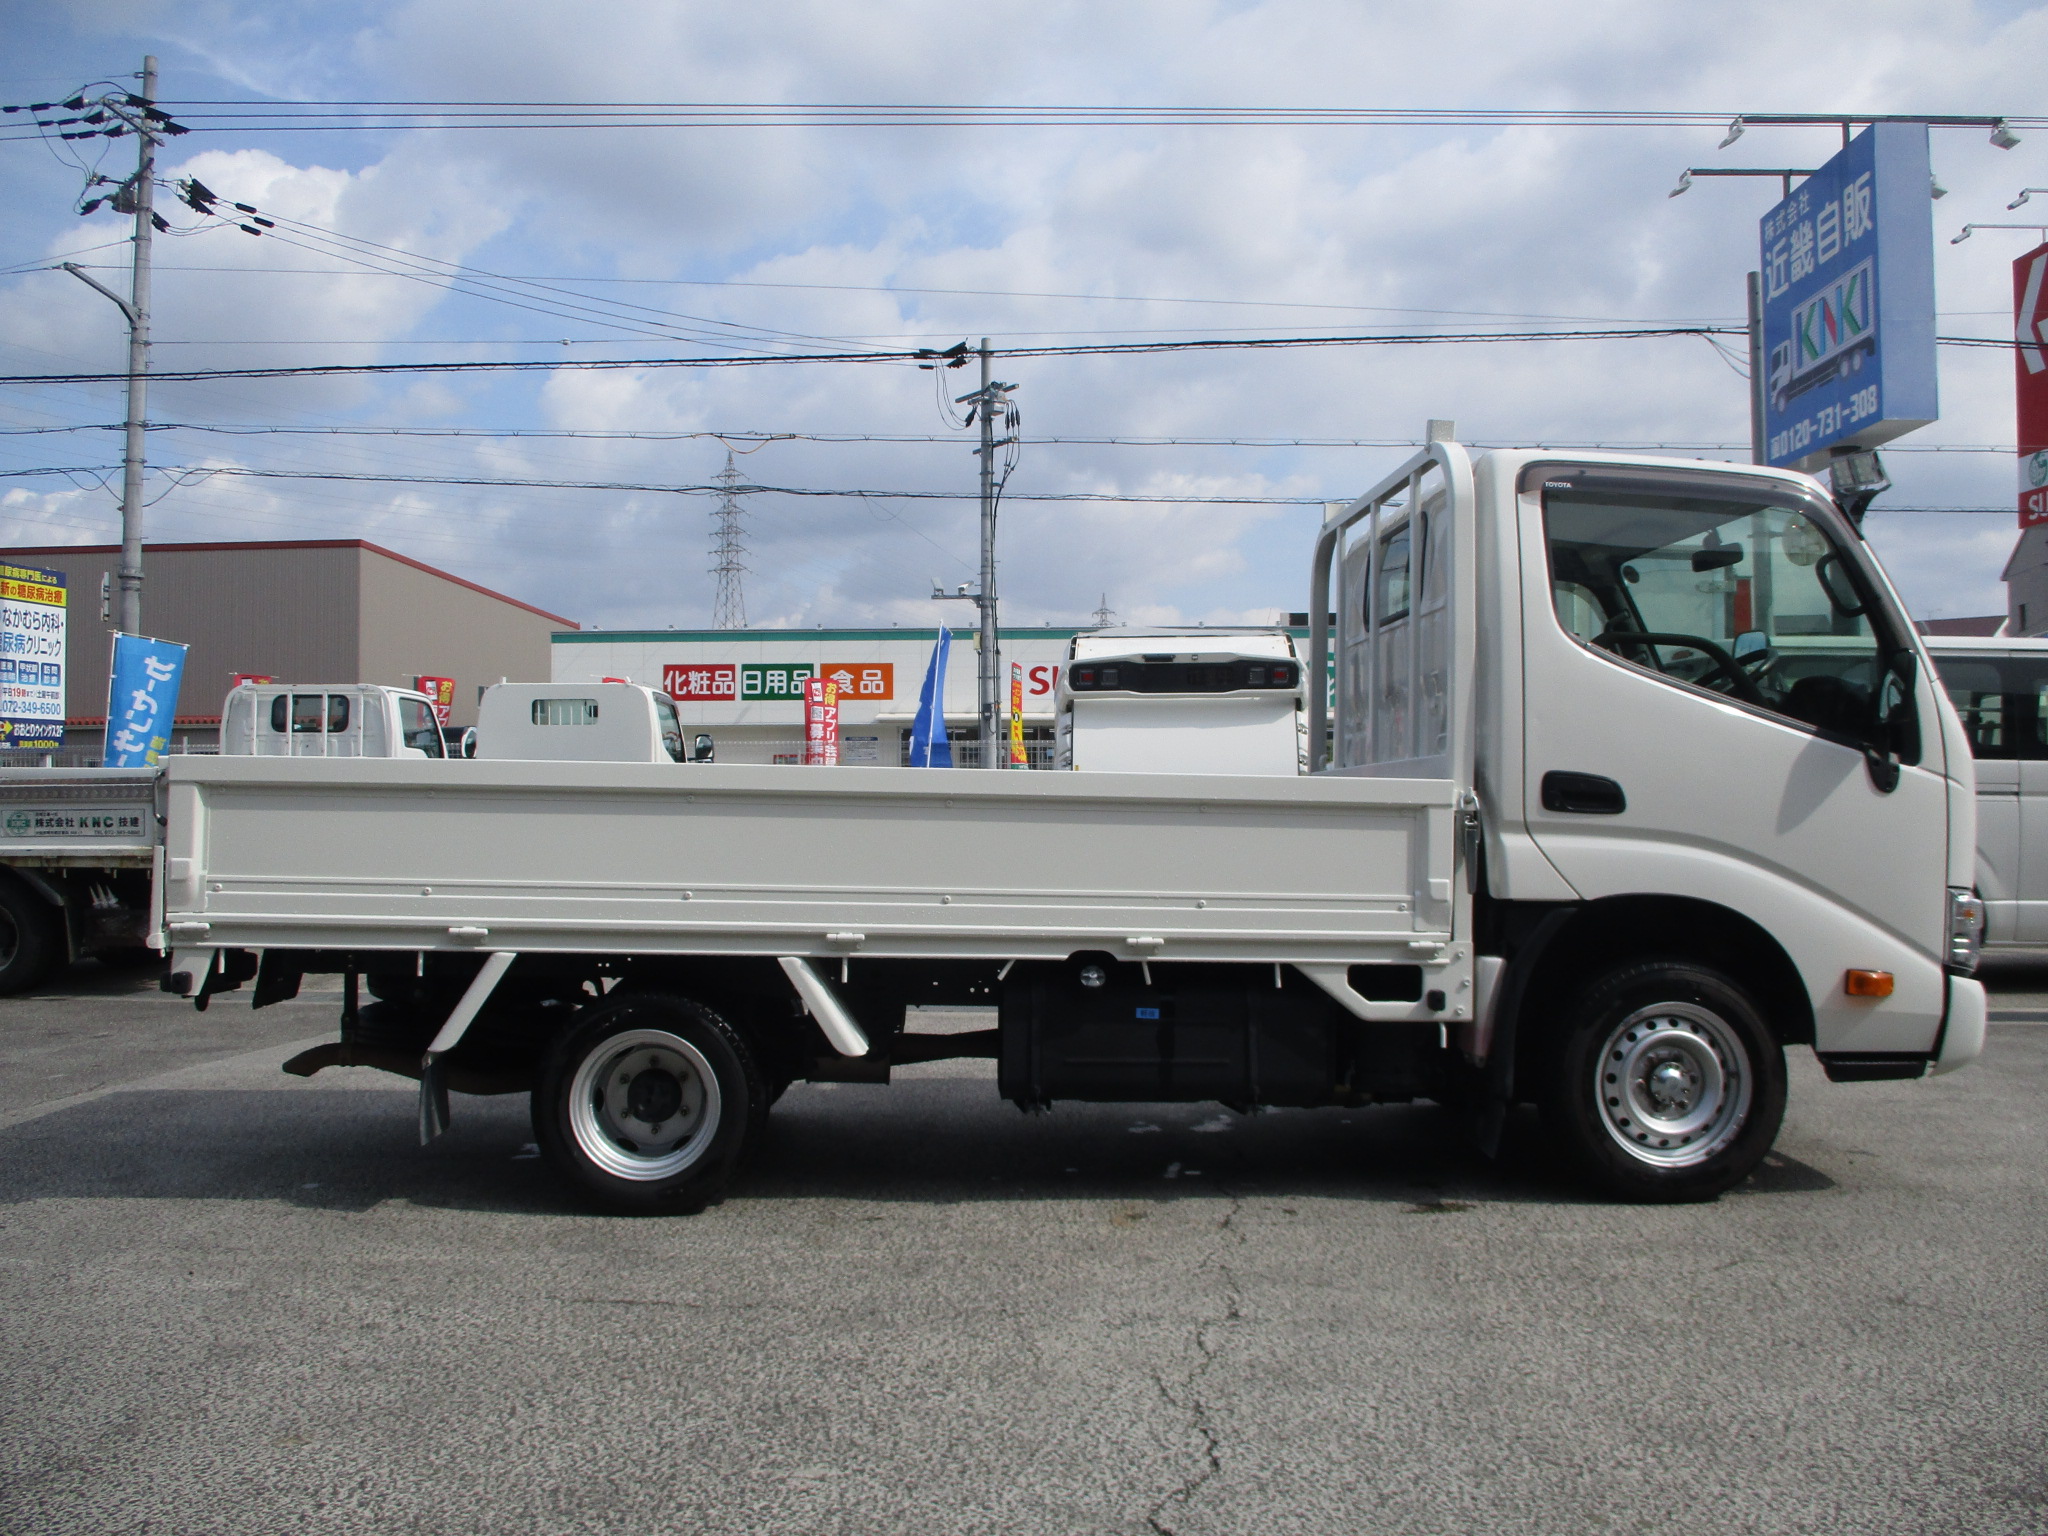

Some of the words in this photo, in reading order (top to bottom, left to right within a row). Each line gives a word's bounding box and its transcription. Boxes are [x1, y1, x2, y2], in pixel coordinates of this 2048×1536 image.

[1765, 189, 1810, 244] 株式会社
[1766, 171, 1873, 304] 近畿自販
[0, 632, 61, 656] 尿病クリニック
[664, 670, 734, 695] 化粧品
[742, 670, 811, 694] 日用品
[830, 670, 884, 694] 食品
[3, 700, 60, 715] 072-349-6500
[36, 818, 74, 828] 株式会社
[80, 816, 114, 828] KNC
